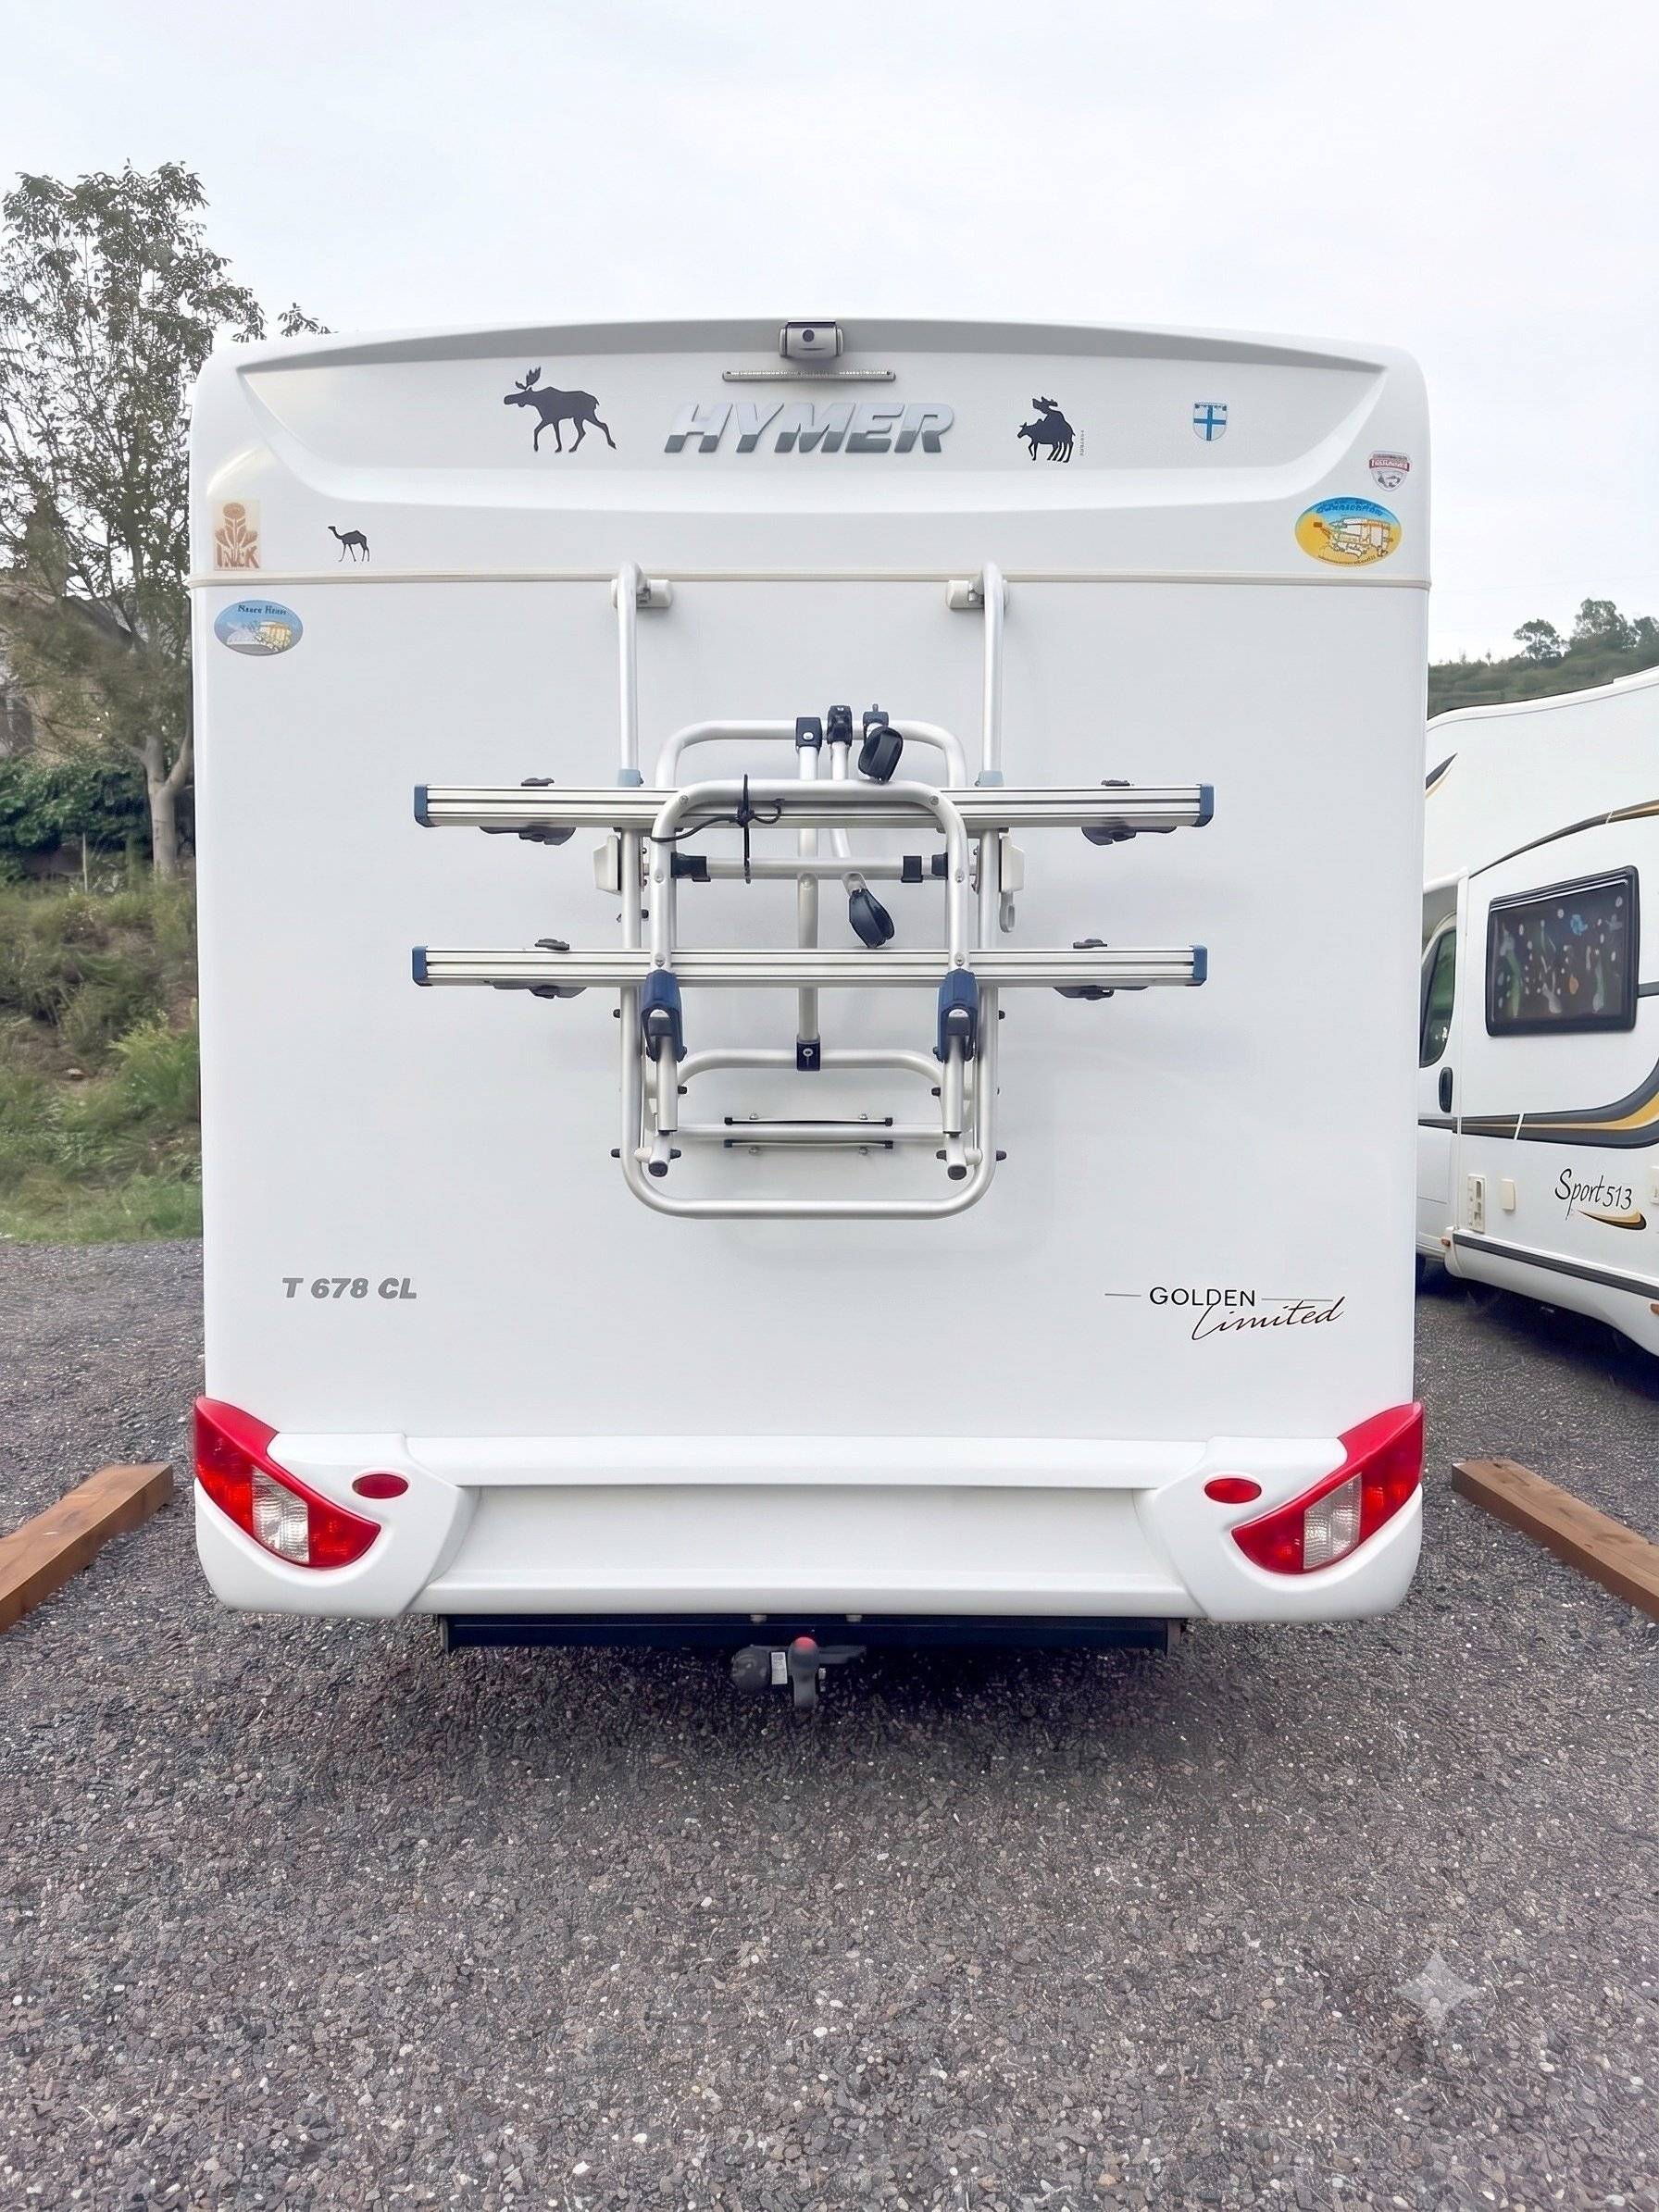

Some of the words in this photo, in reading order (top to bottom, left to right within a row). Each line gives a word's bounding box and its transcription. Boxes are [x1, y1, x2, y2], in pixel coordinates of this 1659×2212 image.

[664, 403, 955, 454] HYMER
[281, 1277, 304, 1299] T
[310, 1277, 368, 1299] 678
[378, 1277, 417, 1299] CL
[1149, 1286, 1255, 1307] GOLDEN
[1191, 1295, 1345, 1340] Limited
